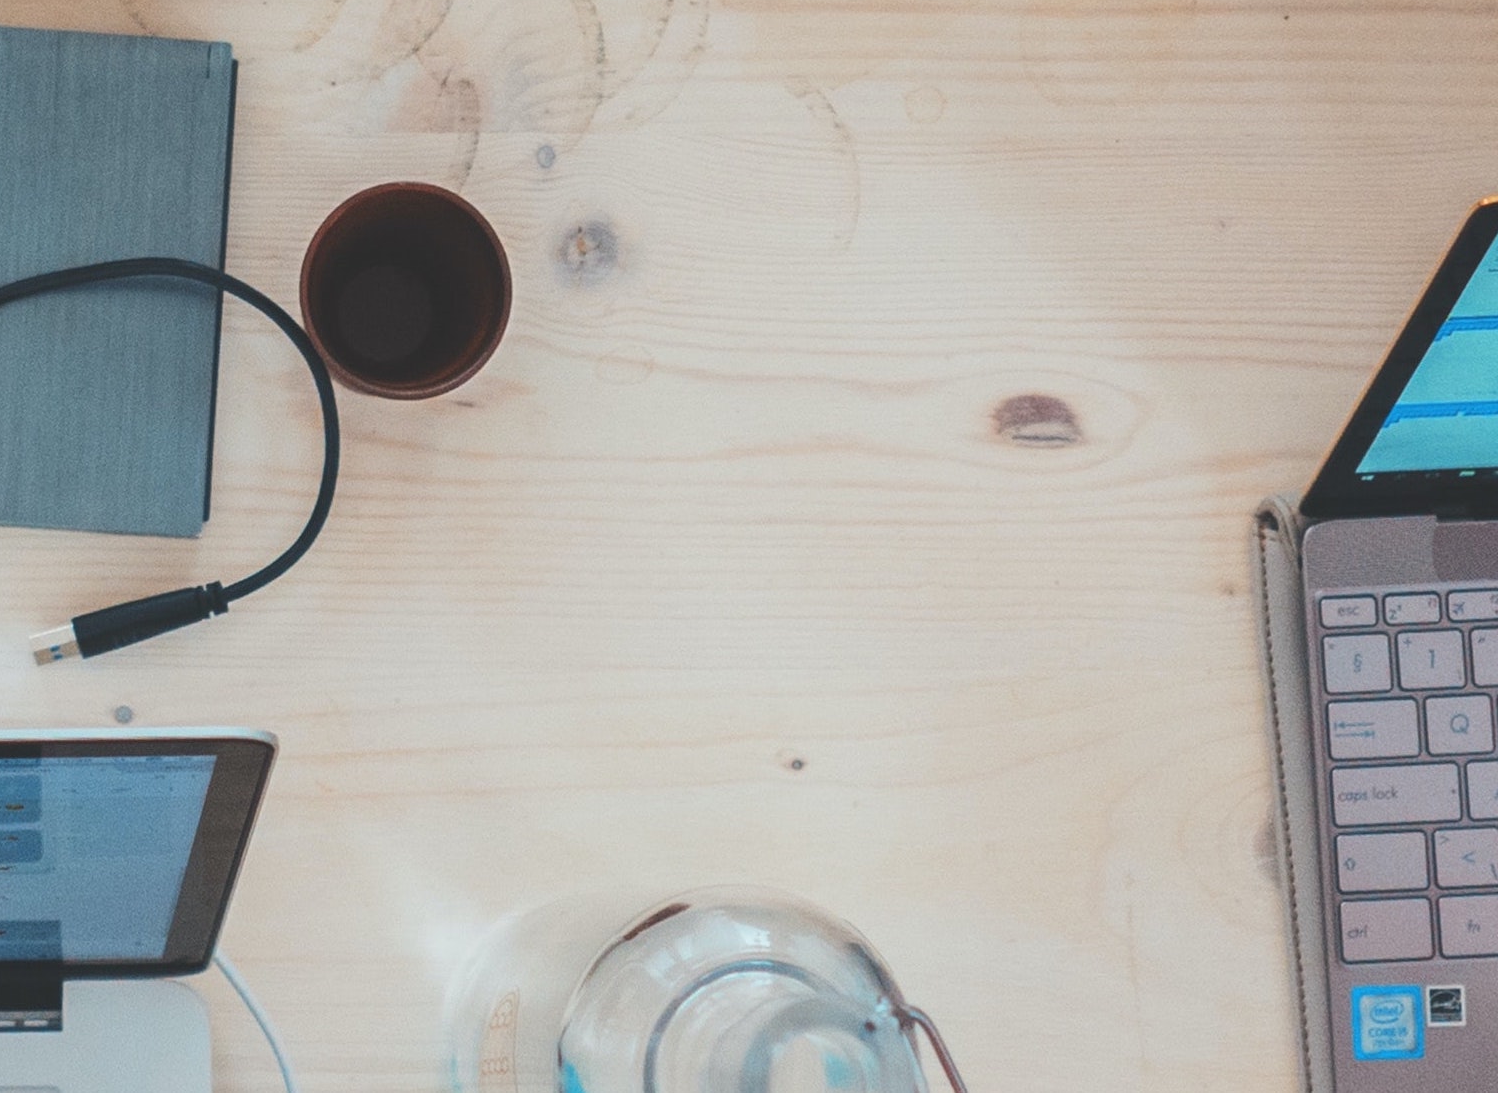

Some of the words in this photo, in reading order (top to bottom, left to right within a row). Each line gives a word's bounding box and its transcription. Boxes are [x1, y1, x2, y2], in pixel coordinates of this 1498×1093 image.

[1427, 648, 1436, 670] 1
[1448, 712, 1471, 735] Q
[1338, 790, 1369, 804] caps
[1371, 785, 1399, 801] lock
